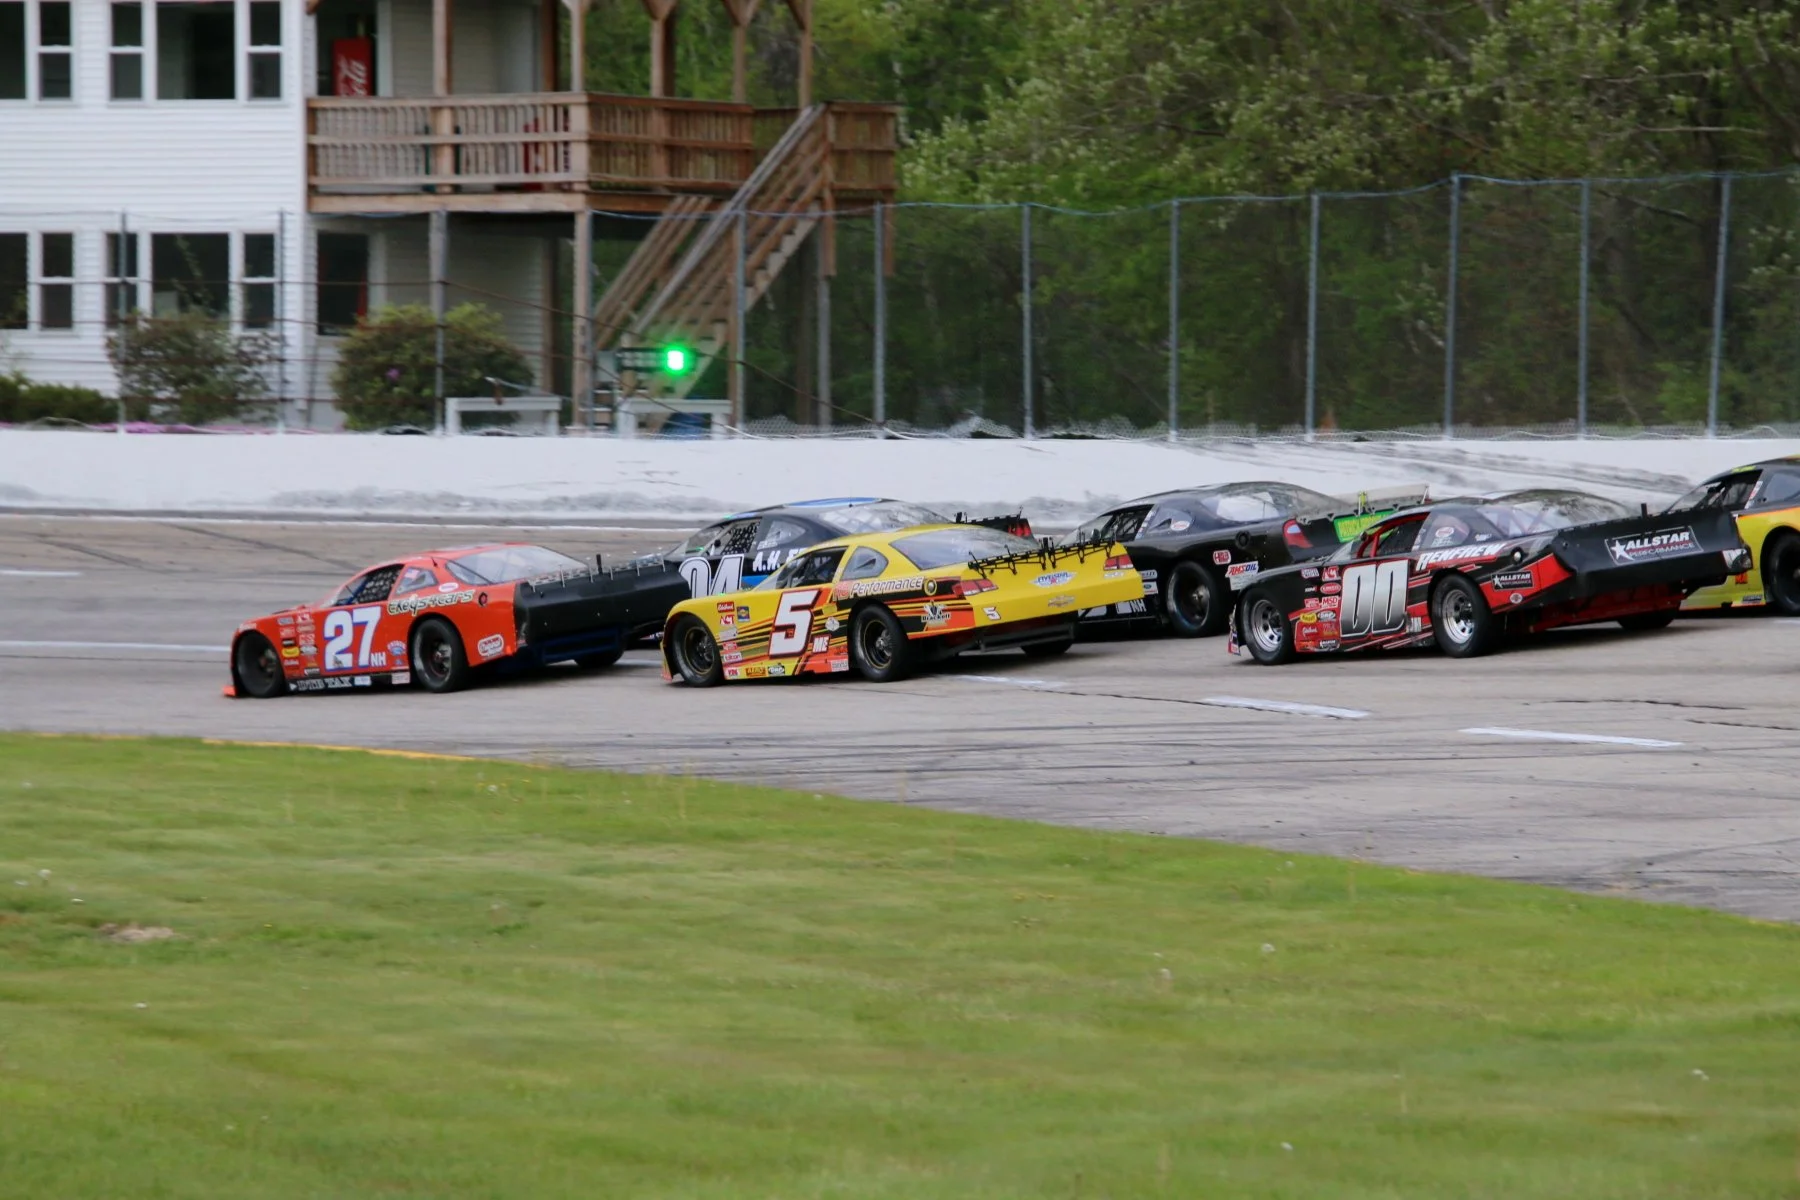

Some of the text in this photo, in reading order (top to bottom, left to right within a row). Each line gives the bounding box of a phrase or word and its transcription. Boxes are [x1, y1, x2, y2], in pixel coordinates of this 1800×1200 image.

[1626, 531, 1690, 550] ALLSTAR
[1416, 542, 1507, 571] RENFREW
[1629, 543, 1696, 557] PERFORMANCE
[1229, 563, 1257, 576] AMSOIL
[1501, 573, 1531, 581] ALLSTAR
[1130, 599, 1147, 613] NH
[1340, 559, 1408, 638] 00
[980, 606, 1001, 621] 5
[769, 588, 822, 659] 5
[324, 606, 381, 671] 27
[371, 652, 387, 667] NH
